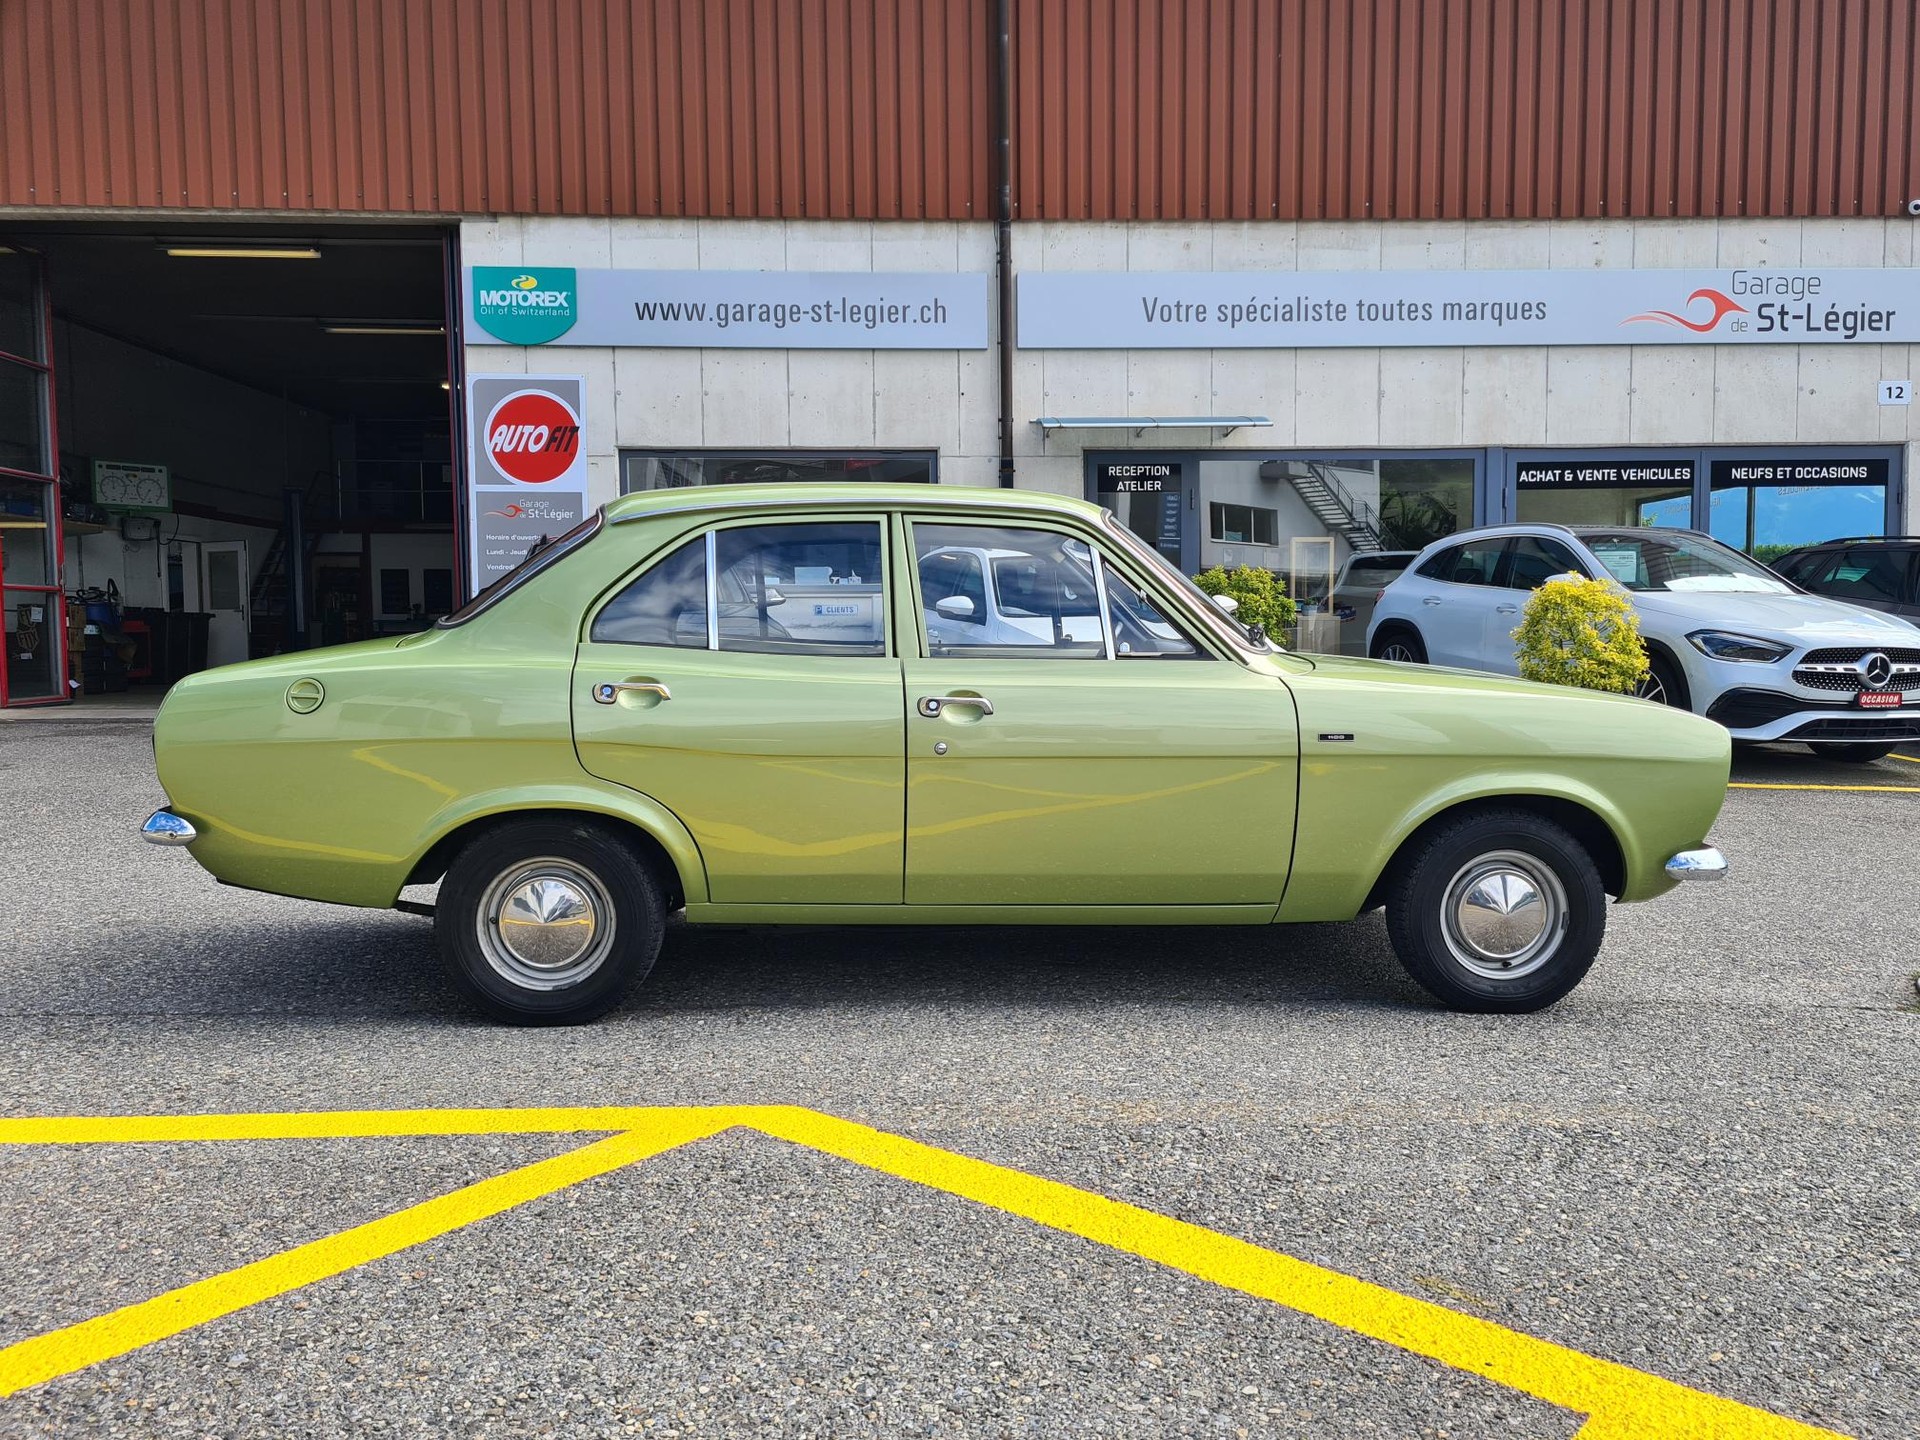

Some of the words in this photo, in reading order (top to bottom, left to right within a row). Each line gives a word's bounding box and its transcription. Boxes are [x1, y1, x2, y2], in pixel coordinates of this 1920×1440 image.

[1732, 270, 1821, 301] Garage
[480, 290, 569, 307] MOTOREX
[481, 307, 494, 315] Oil
[498, 307, 508, 315] of
[511, 307, 570, 316] Switzerland
[634, 297, 947, 329] www.garage-st-legier.ch
[1142, 296, 1207, 322] Votre
[1217, 296, 1347, 328] spécialiste
[1356, 298, 1433, 322] toutes
[1442, 301, 1547, 326] marques
[1731, 318, 1748, 332] de
[1757, 303, 1896, 339] St-Légier
[1886, 386, 1904, 399] 12
[1108, 465, 1170, 476] RECEPTION
[1519, 470, 1561, 482] ACHAT
[1564, 470, 1574, 482] &
[1577, 469, 1617, 481] VENTE
[1621, 468, 1691, 480] VEHICULES
[1731, 467, 1773, 479] NEUFS
[1777, 467, 1792, 479] ET
[1795, 466, 1868, 479] OCCASIONS
[1116, 481, 1162, 491] ATELIER
[519, 499, 549, 509] Garage
[528, 508, 574, 521] St-Légier
[1861, 695, 1899, 703] OCCASION
